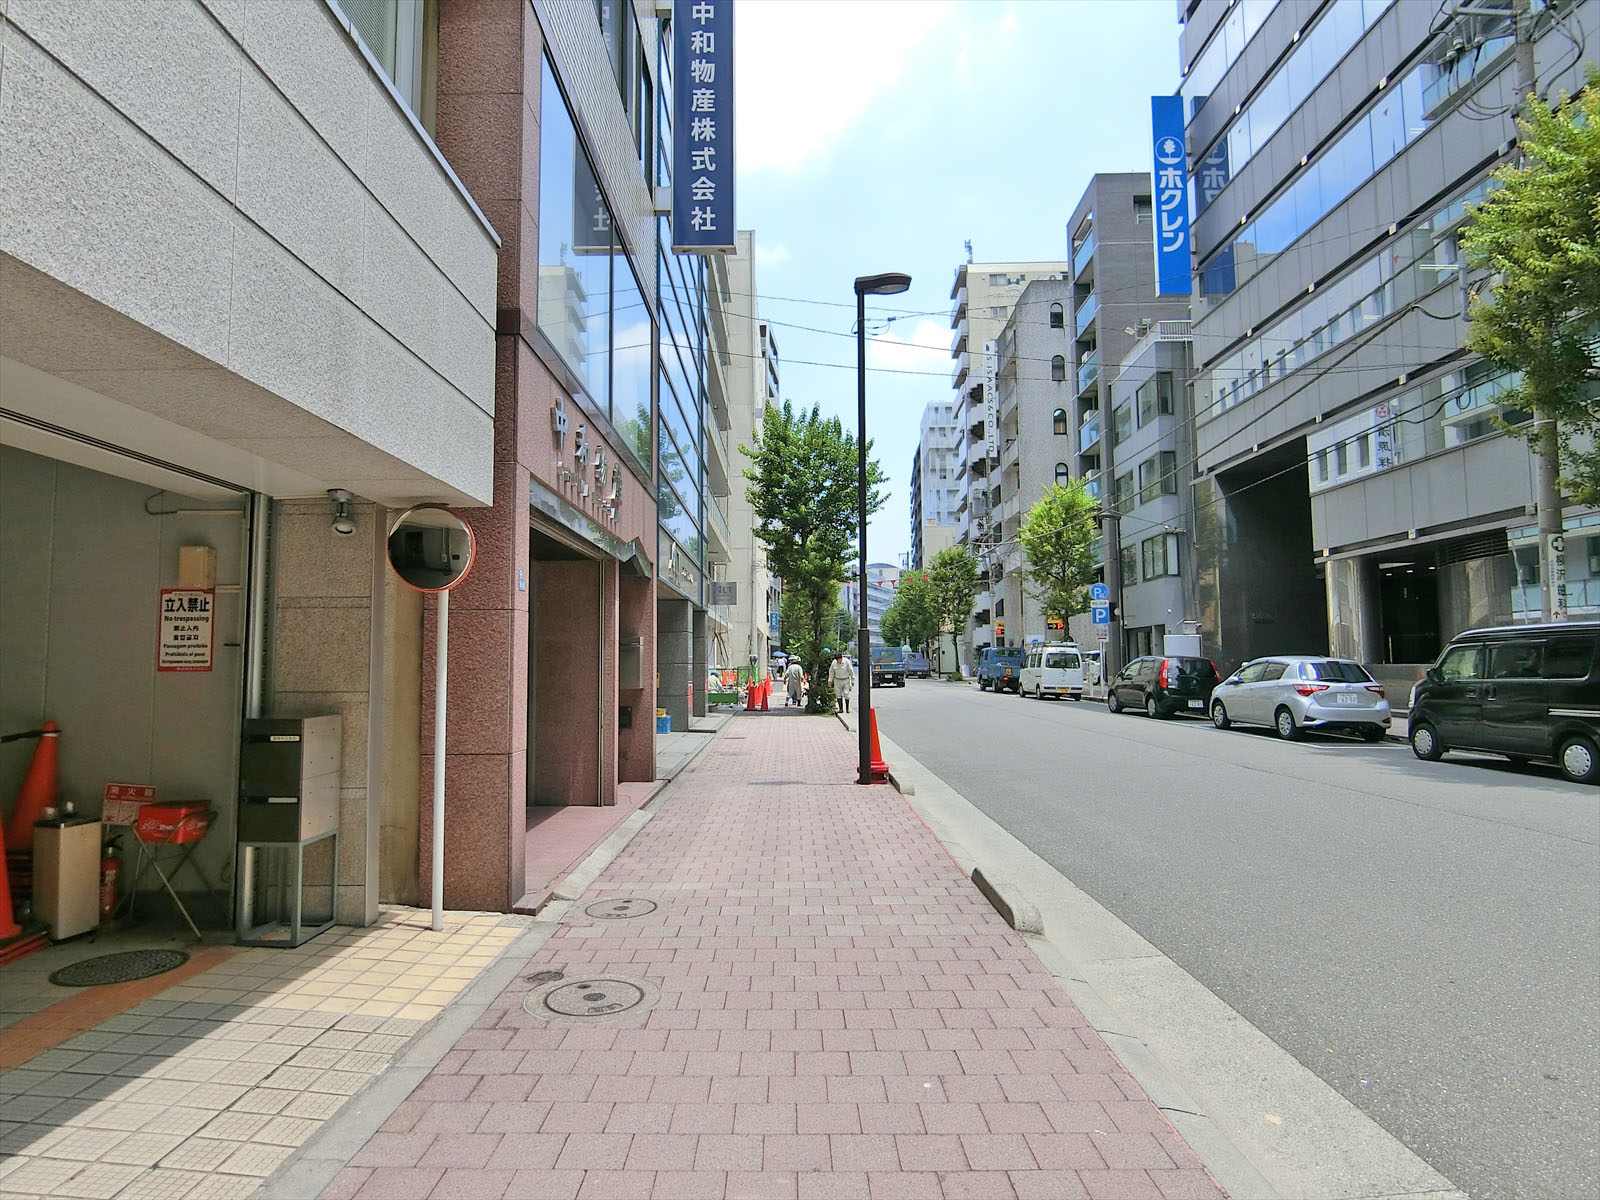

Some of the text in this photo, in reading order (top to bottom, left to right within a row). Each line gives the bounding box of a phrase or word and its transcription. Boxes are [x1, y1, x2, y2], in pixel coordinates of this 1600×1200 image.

[691, 2, 716, 231] 中和物産株式会社
[1159, 168, 1184, 252] ホクレン
[1094, 588, 1102, 600] P
[164, 598, 210, 612] 立入禁止
[1096, 609, 1106, 623] P
